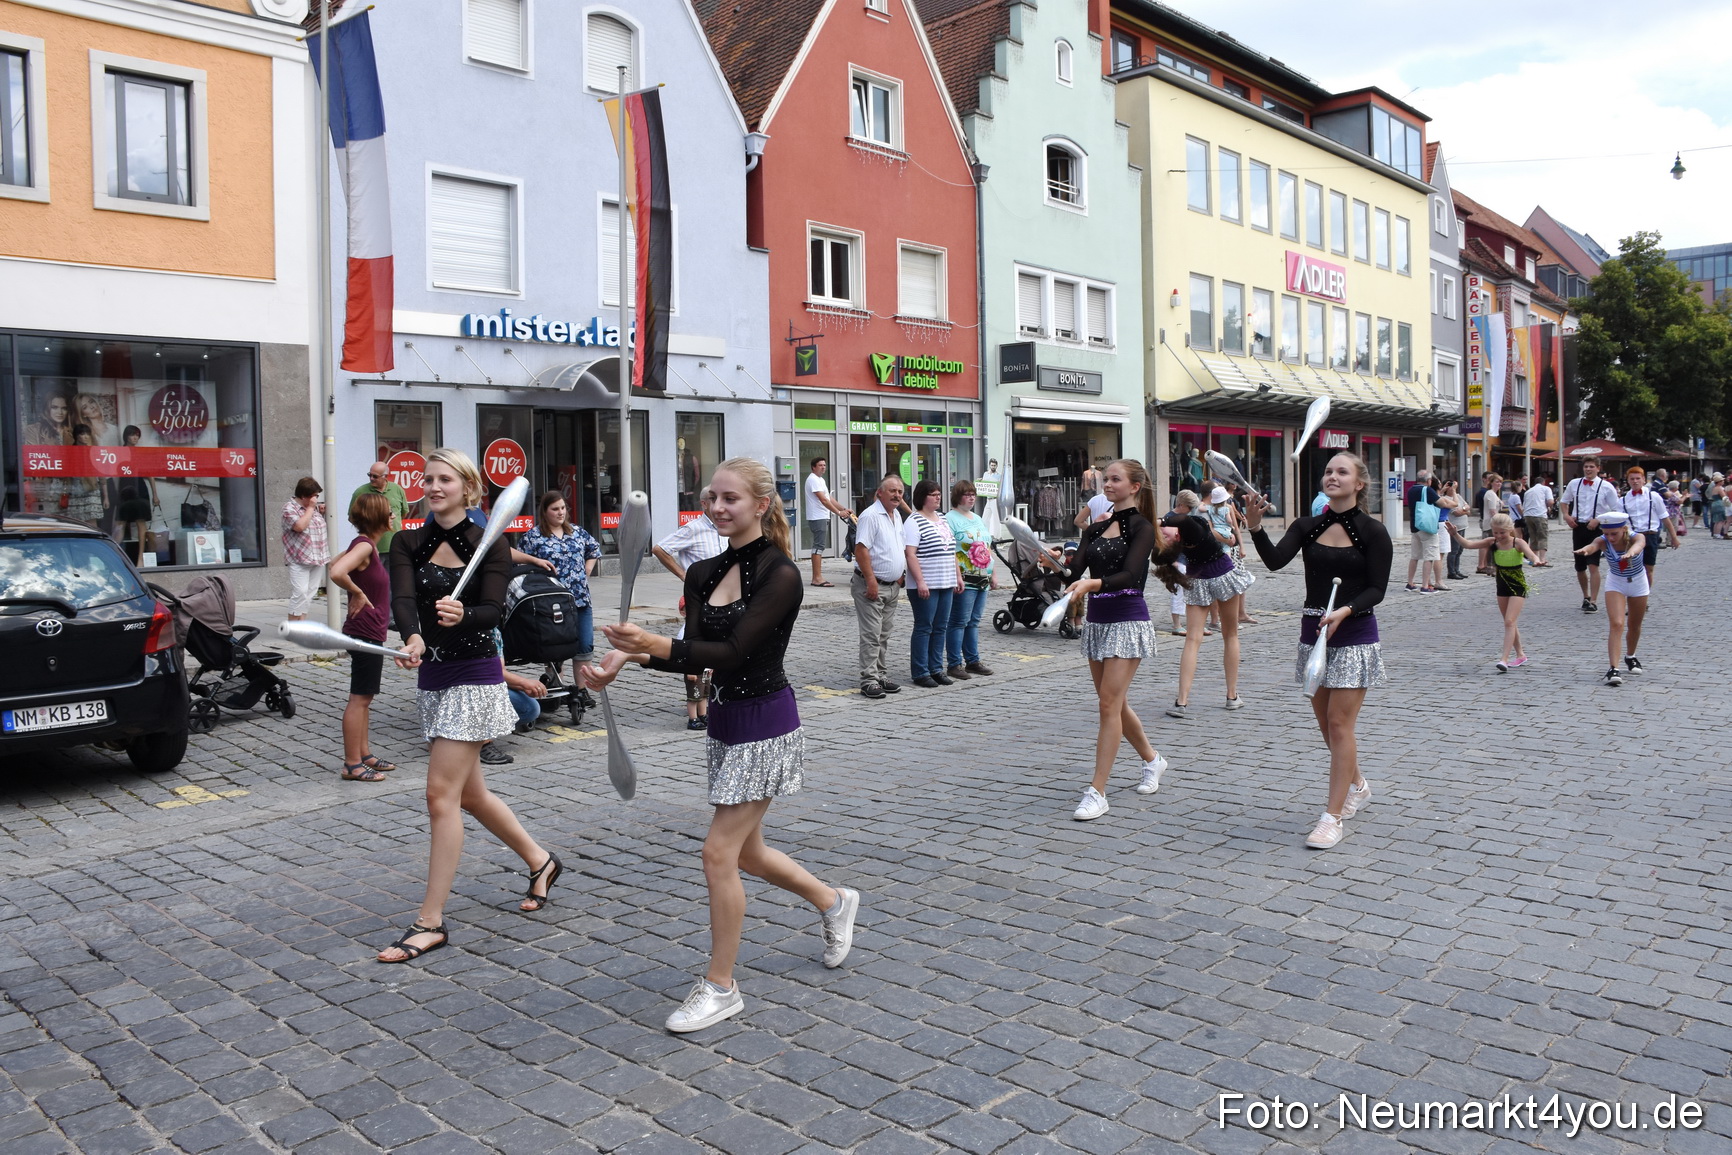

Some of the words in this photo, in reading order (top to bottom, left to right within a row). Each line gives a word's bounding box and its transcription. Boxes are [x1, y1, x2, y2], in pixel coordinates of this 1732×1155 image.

[1294, 254, 1346, 300] ADLER
[466, 307, 582, 344] mister
[903, 353, 964, 374] mobilcom
[1003, 362, 1030, 373] BONITA
[903, 371, 940, 390] debitel
[1060, 372, 1087, 388] BONITA
[152, 391, 196, 425] for
[162, 409, 205, 435] you!
[851, 421, 878, 432] GRAVIS
[1324, 430, 1350, 449] ADLER
[29, 459, 63, 471] SALE
[167, 460, 197, 471] SALE
[489, 456, 523, 476] 70%
[390, 470, 425, 490] 70%
[14, 709, 38, 727] NM
[48, 706, 71, 722] KB
[75, 702, 105, 719] 138
